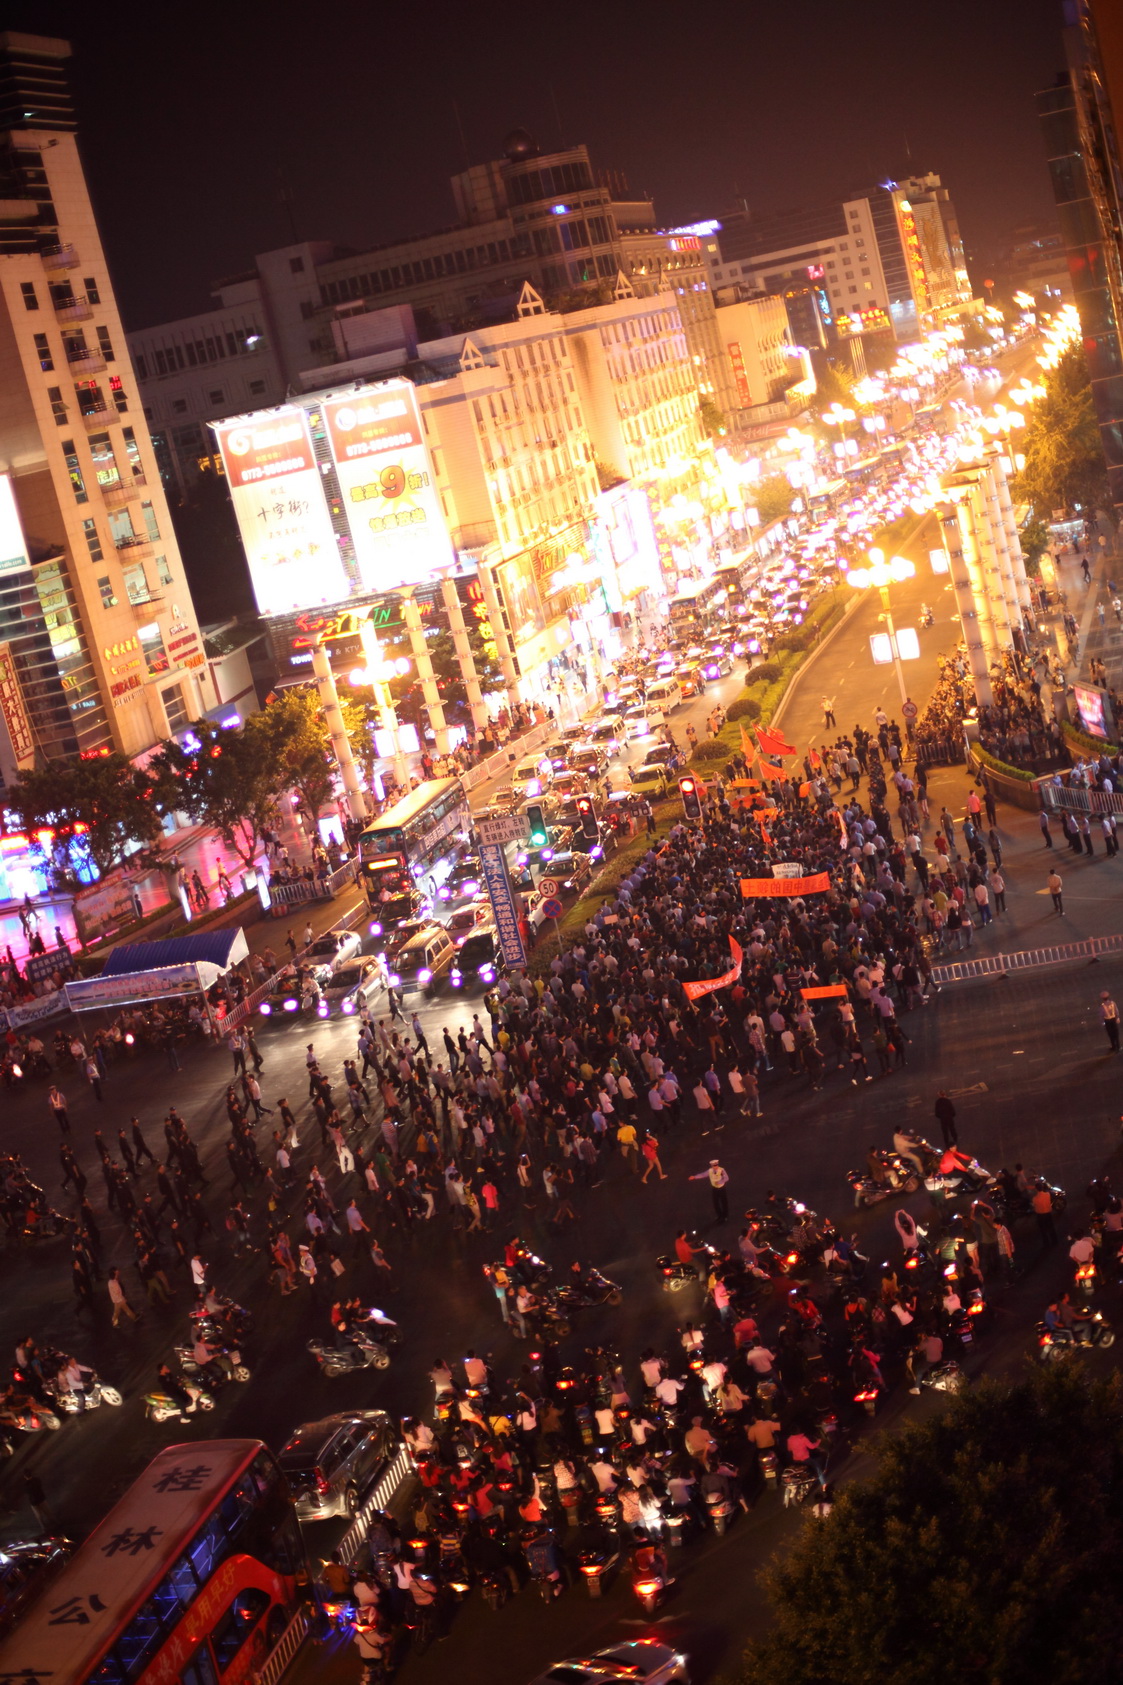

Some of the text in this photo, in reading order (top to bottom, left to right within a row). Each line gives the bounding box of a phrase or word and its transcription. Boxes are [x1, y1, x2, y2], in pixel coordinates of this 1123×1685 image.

[344, 644, 360, 654] KTV
[483, 816, 525, 834] 直行绿灯、左转
[543, 882, 555, 895] 50
